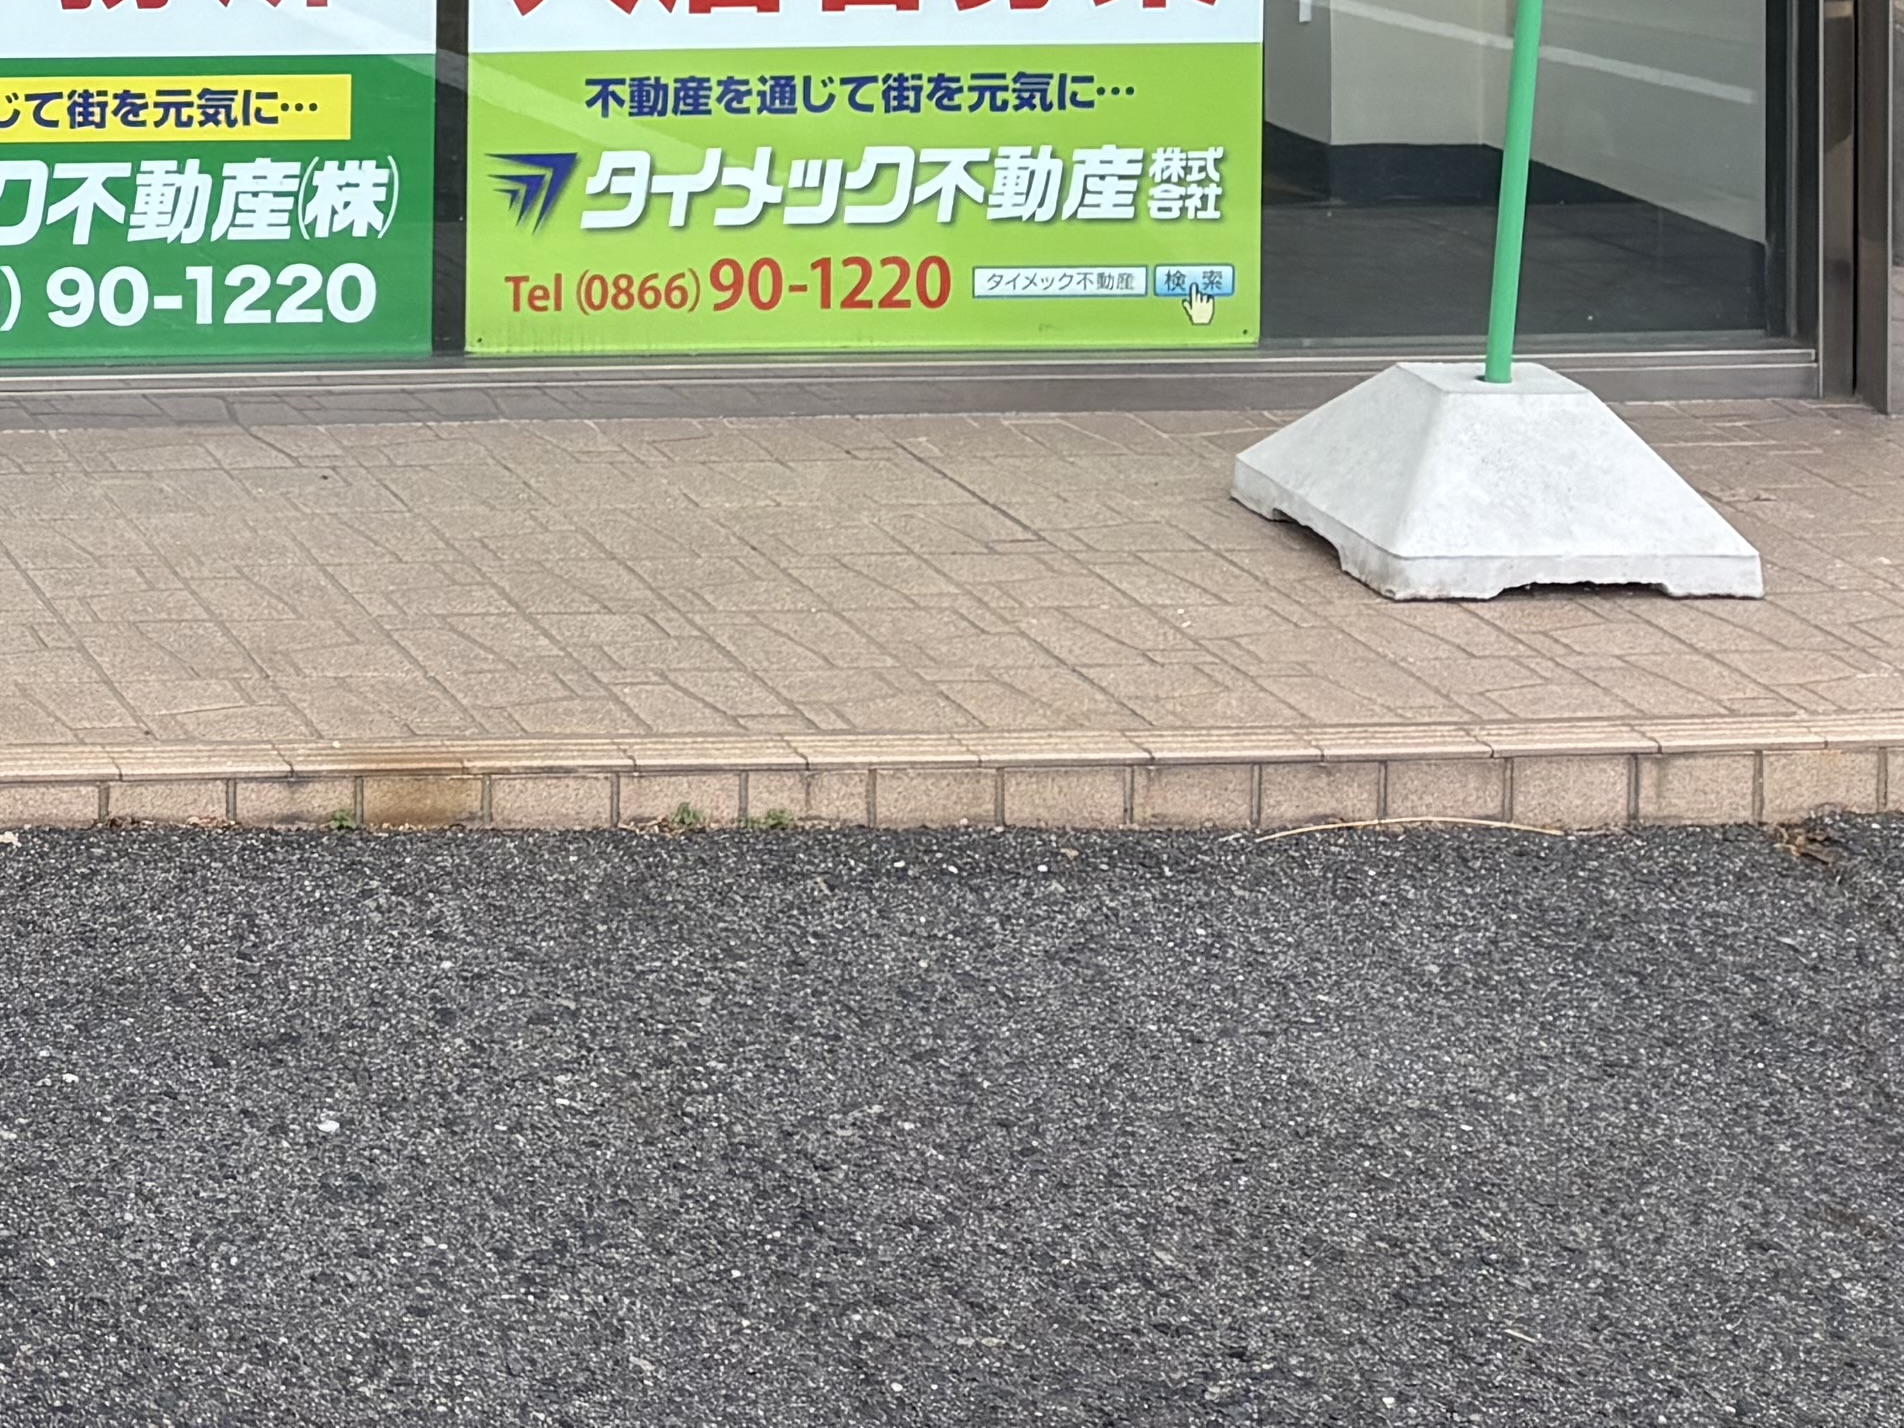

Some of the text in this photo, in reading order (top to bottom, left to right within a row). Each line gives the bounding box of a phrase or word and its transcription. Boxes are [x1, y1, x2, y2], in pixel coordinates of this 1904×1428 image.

[580, 144, 1144, 229] タイメック不動産
[46, 263, 376, 327] 90-1220
[505, 255, 952, 316] Tel (0866) 90-1220
[986, 270, 1135, 291] タイメック不動産
